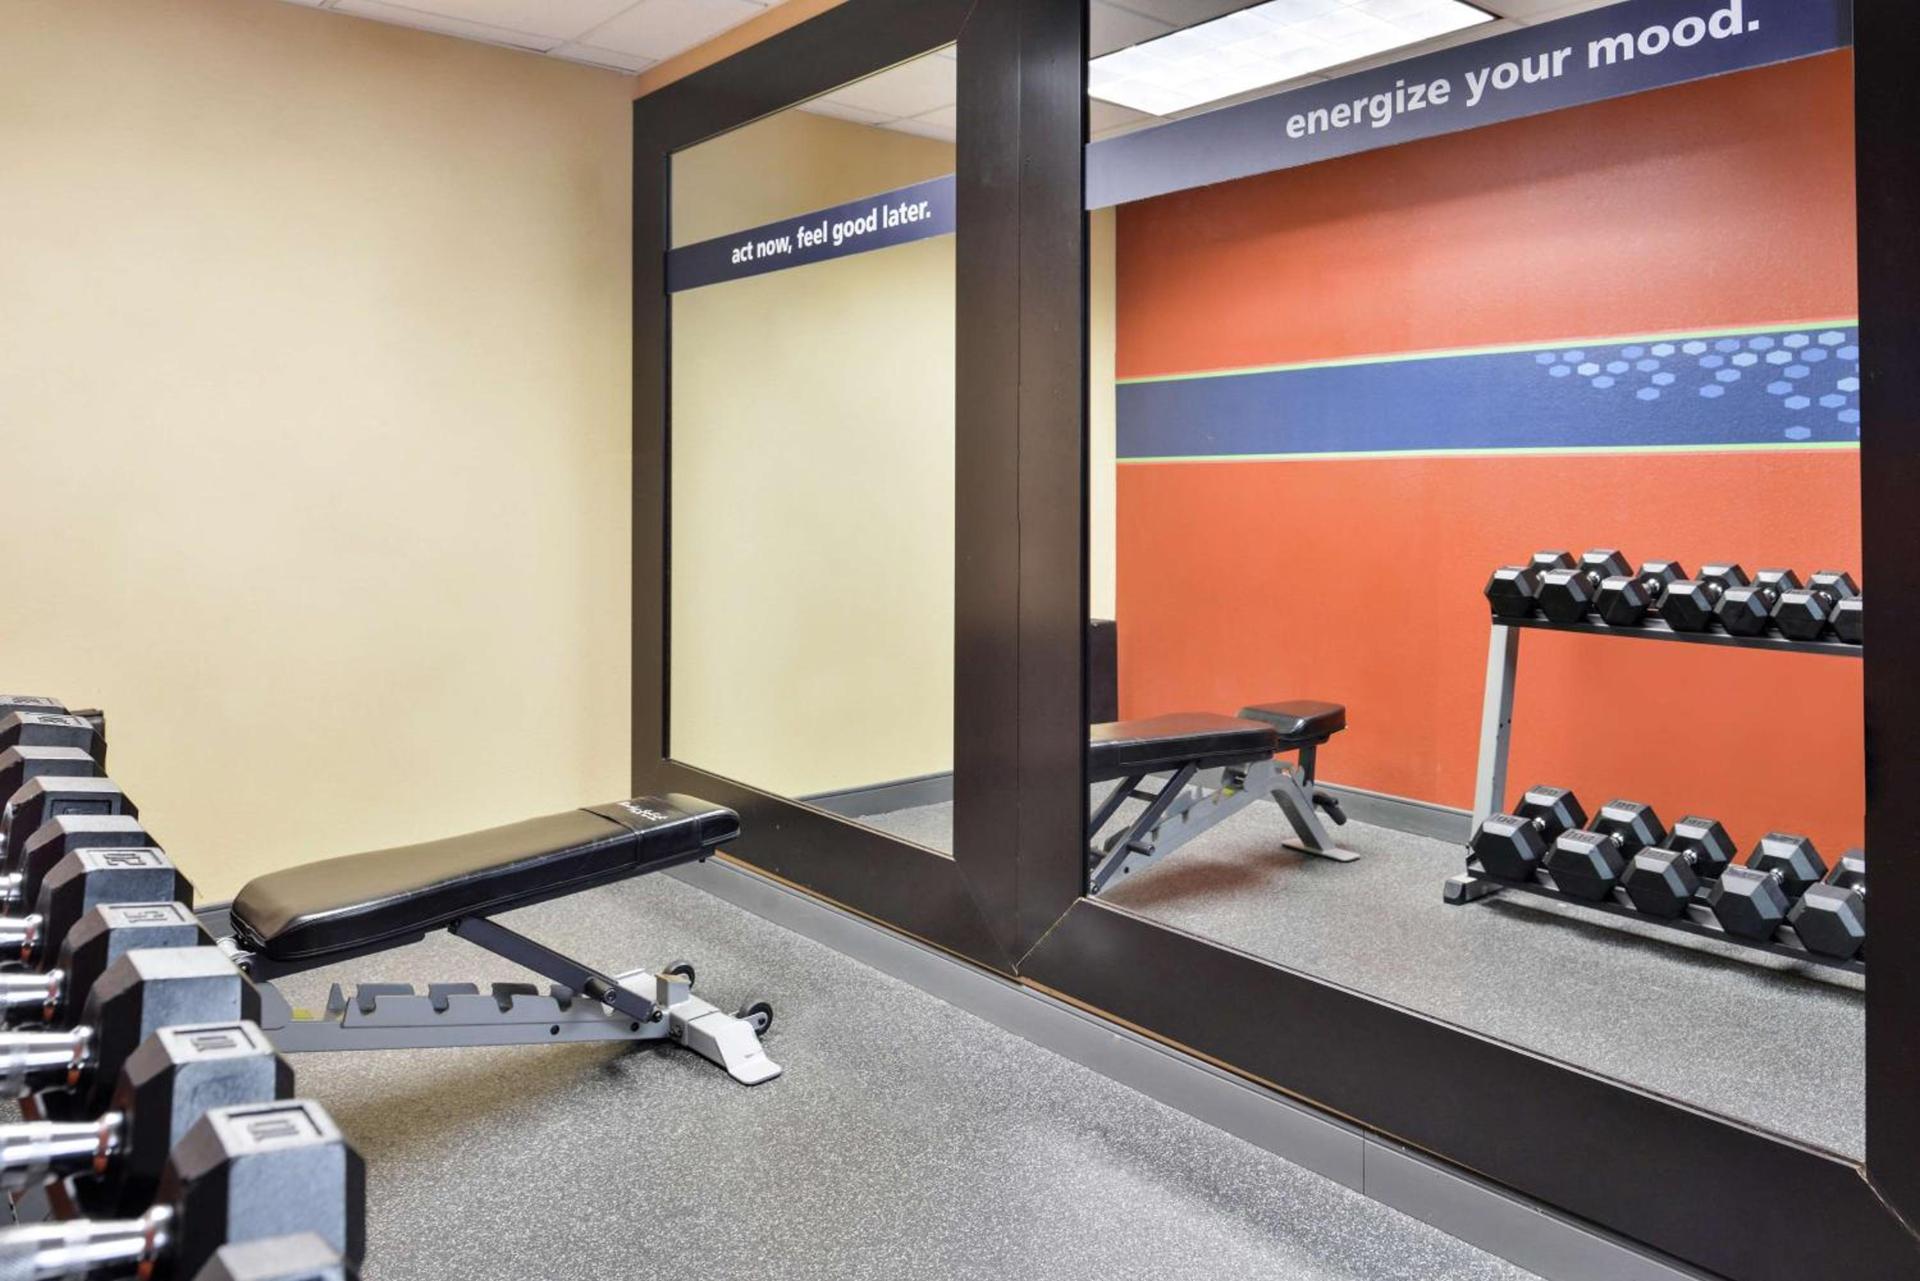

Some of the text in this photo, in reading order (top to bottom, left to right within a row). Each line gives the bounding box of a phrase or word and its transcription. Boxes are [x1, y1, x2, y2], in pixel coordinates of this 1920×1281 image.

[1286, 0, 1759, 139] energize your mood.
[731, 200, 932, 264] act now, feel good later.
